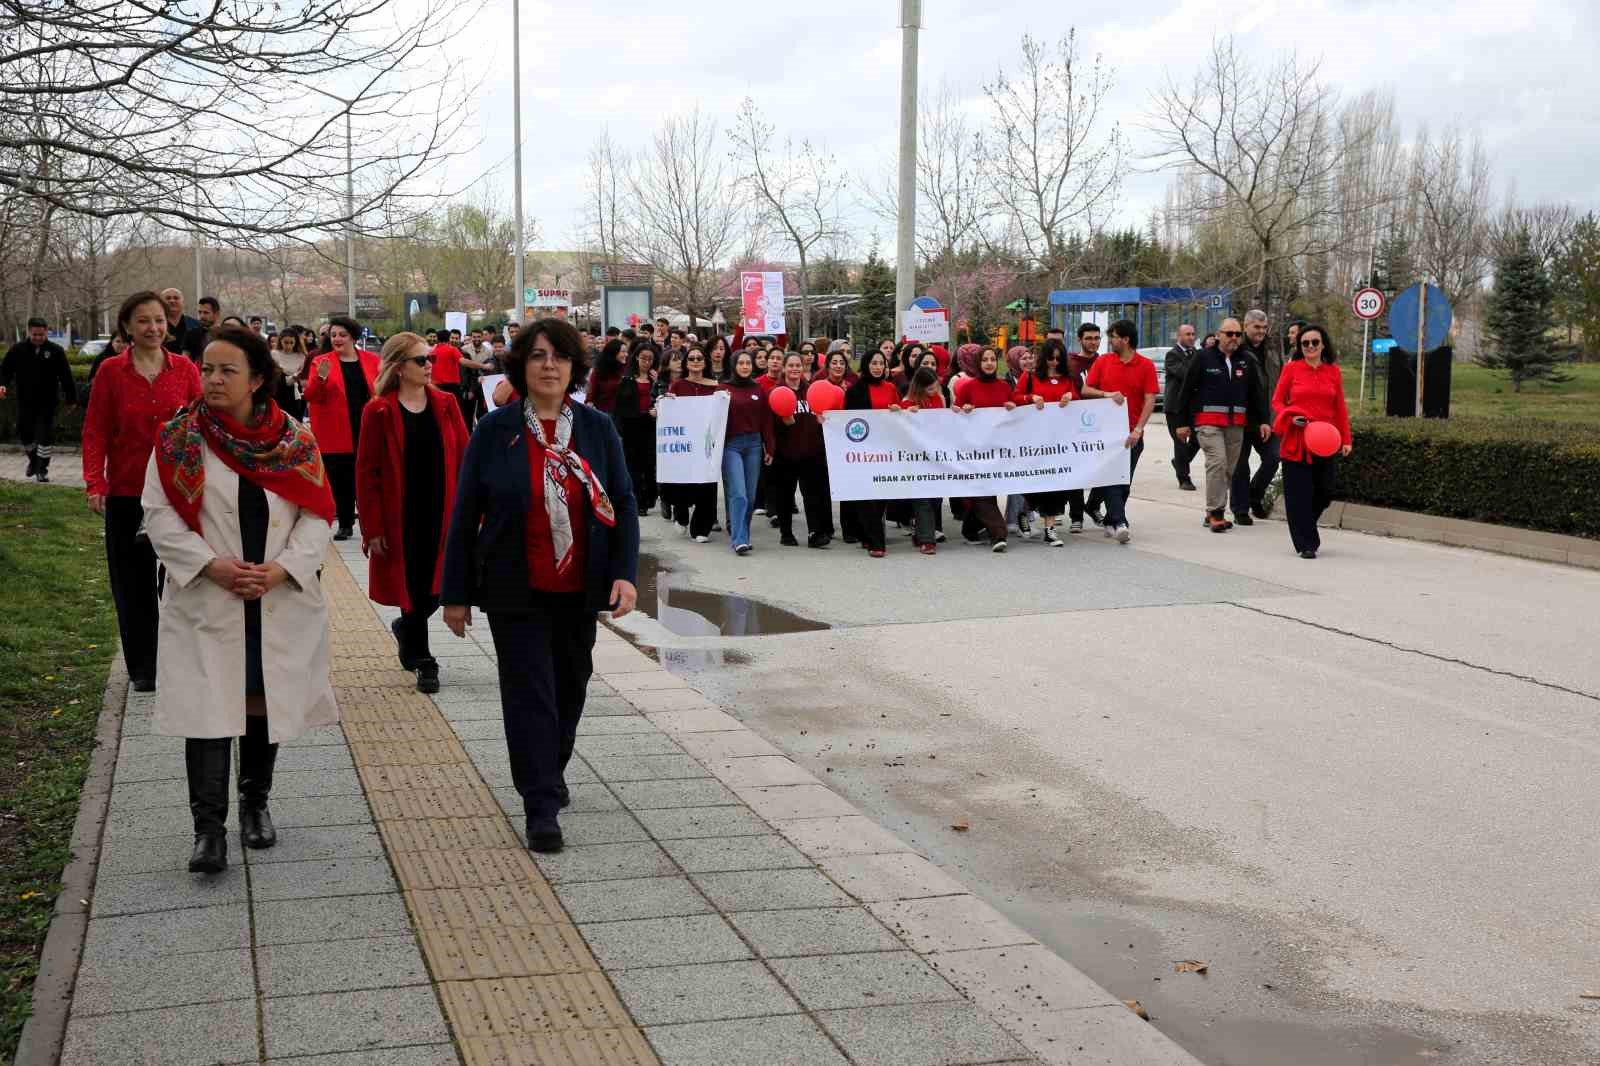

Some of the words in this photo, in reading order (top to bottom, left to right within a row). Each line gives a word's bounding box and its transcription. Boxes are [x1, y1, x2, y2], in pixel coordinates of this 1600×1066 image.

[537, 289, 569, 297] SUPRA
[1361, 299, 1377, 310] 30
[845, 451, 893, 463] Otizmi
[898, 450, 930, 462] Fark
[956, 448, 994, 461] Kabul
[1019, 443, 1069, 457] Bizimle
[1071, 439, 1105, 453] Yürü
[872, 474, 898, 482] NİSAN
[900, 474, 915, 482] AYI
[916, 472, 945, 481] OTİZMİ
[947, 471, 992, 480] FARKETME
[993, 471, 1002, 479] VE
[1004, 467, 1056, 478] KABULLENME
[1058, 466, 1072, 474] AYI
